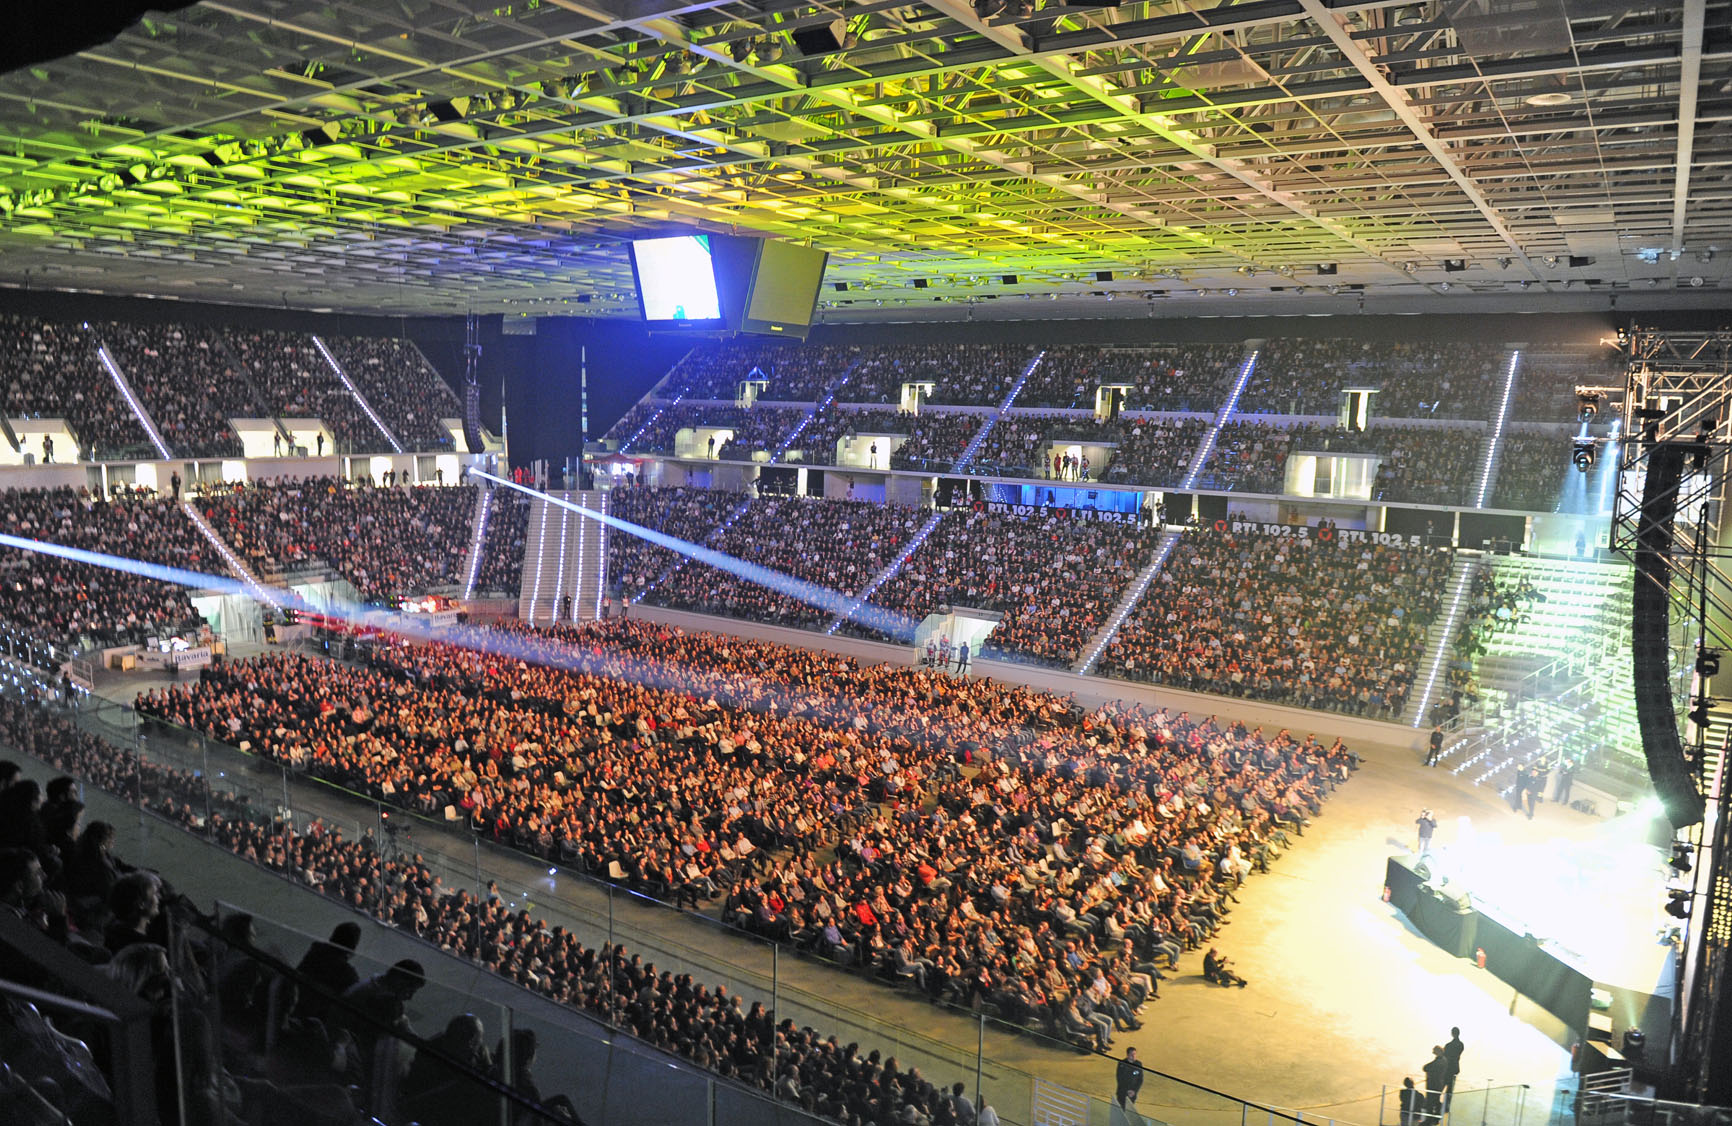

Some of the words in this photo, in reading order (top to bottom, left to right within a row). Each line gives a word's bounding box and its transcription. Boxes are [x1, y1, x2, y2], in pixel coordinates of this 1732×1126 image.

[988, 502, 1010, 514] RTL
[1097, 511, 1137, 524] 102.5
[1232, 521, 1260, 535] RTL
[1263, 524, 1309, 538] 102.5
[1338, 530, 1368, 544] RTL
[1371, 532, 1421, 547] 1025
[434, 613, 457, 621] Bavari
[175, 652, 209, 664] Bavaria
